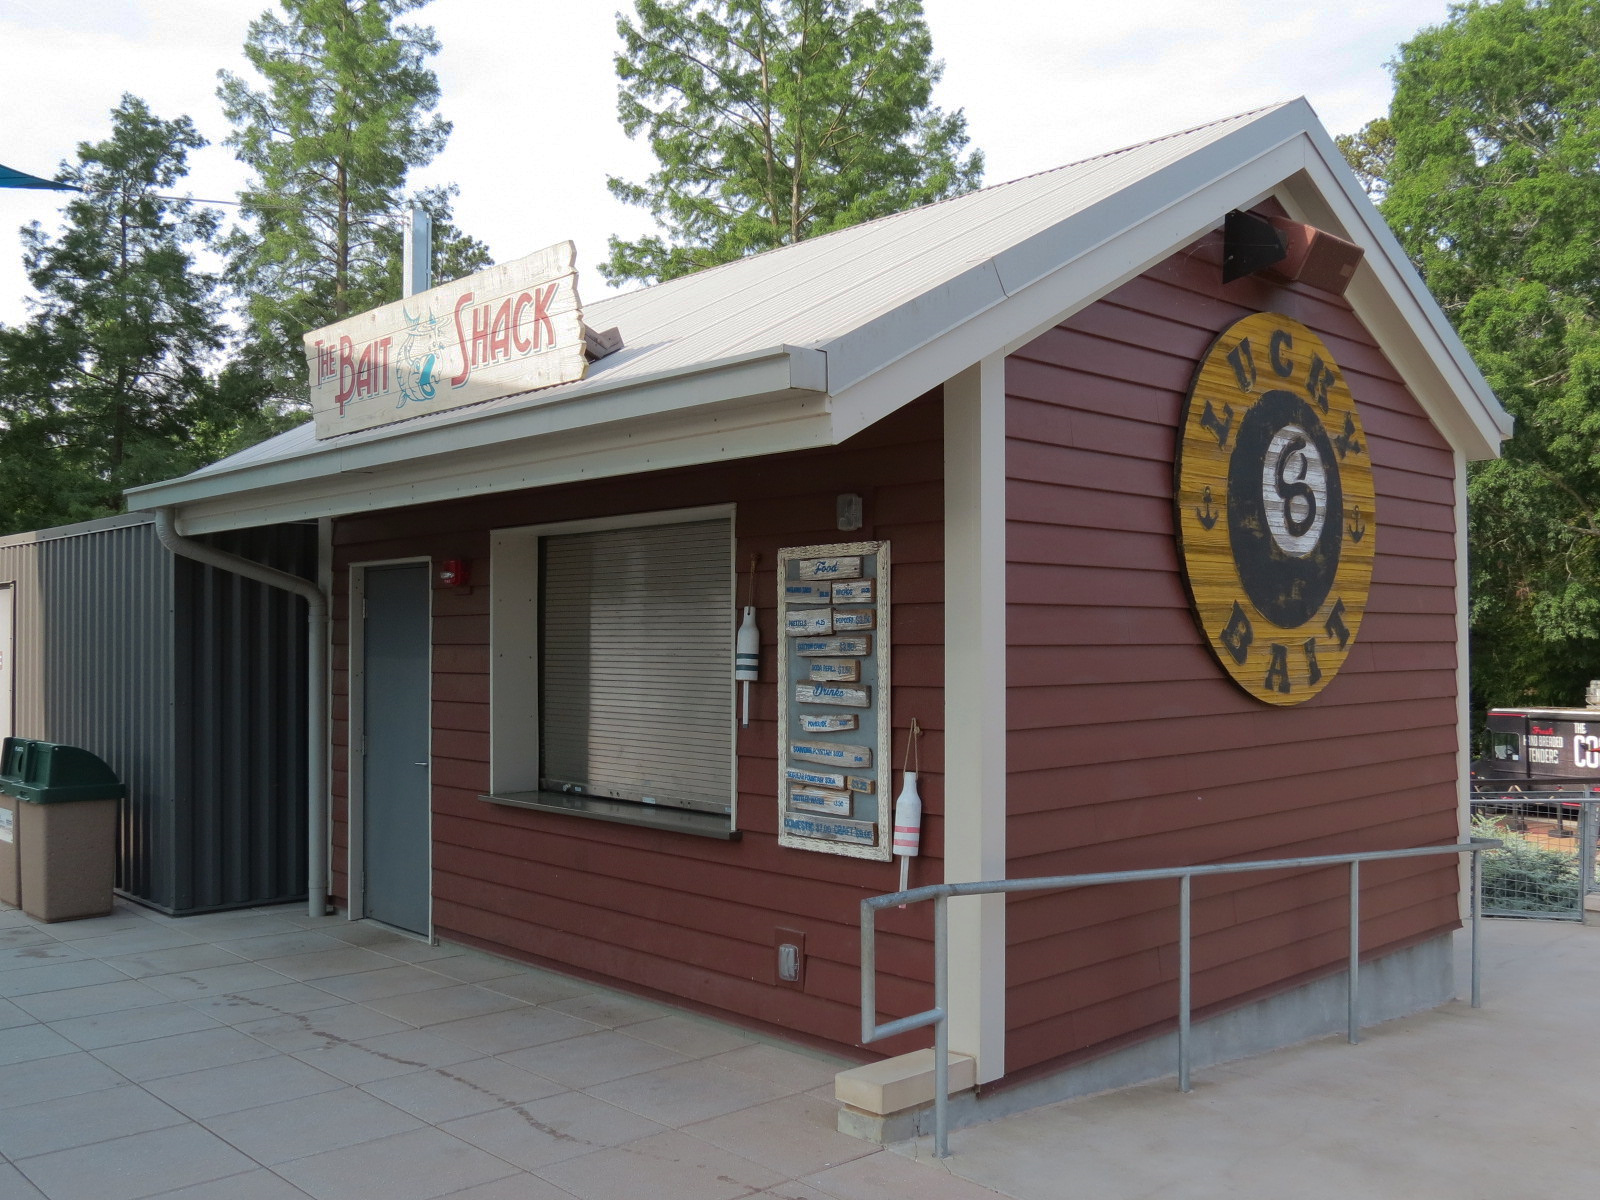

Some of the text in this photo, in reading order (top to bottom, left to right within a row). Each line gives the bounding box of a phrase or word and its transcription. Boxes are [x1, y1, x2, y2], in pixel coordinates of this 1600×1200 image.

[314, 283, 559, 418] THE BAIT SHACK
[1200, 329, 1361, 459] LUCKY
[814, 561, 839, 575] Food
[1219, 597, 1351, 694] BAIT
[812, 683, 845, 698] Drinks
[1573, 722, 1587, 734] THE
[1529, 747, 1559, 764] TENDERS
